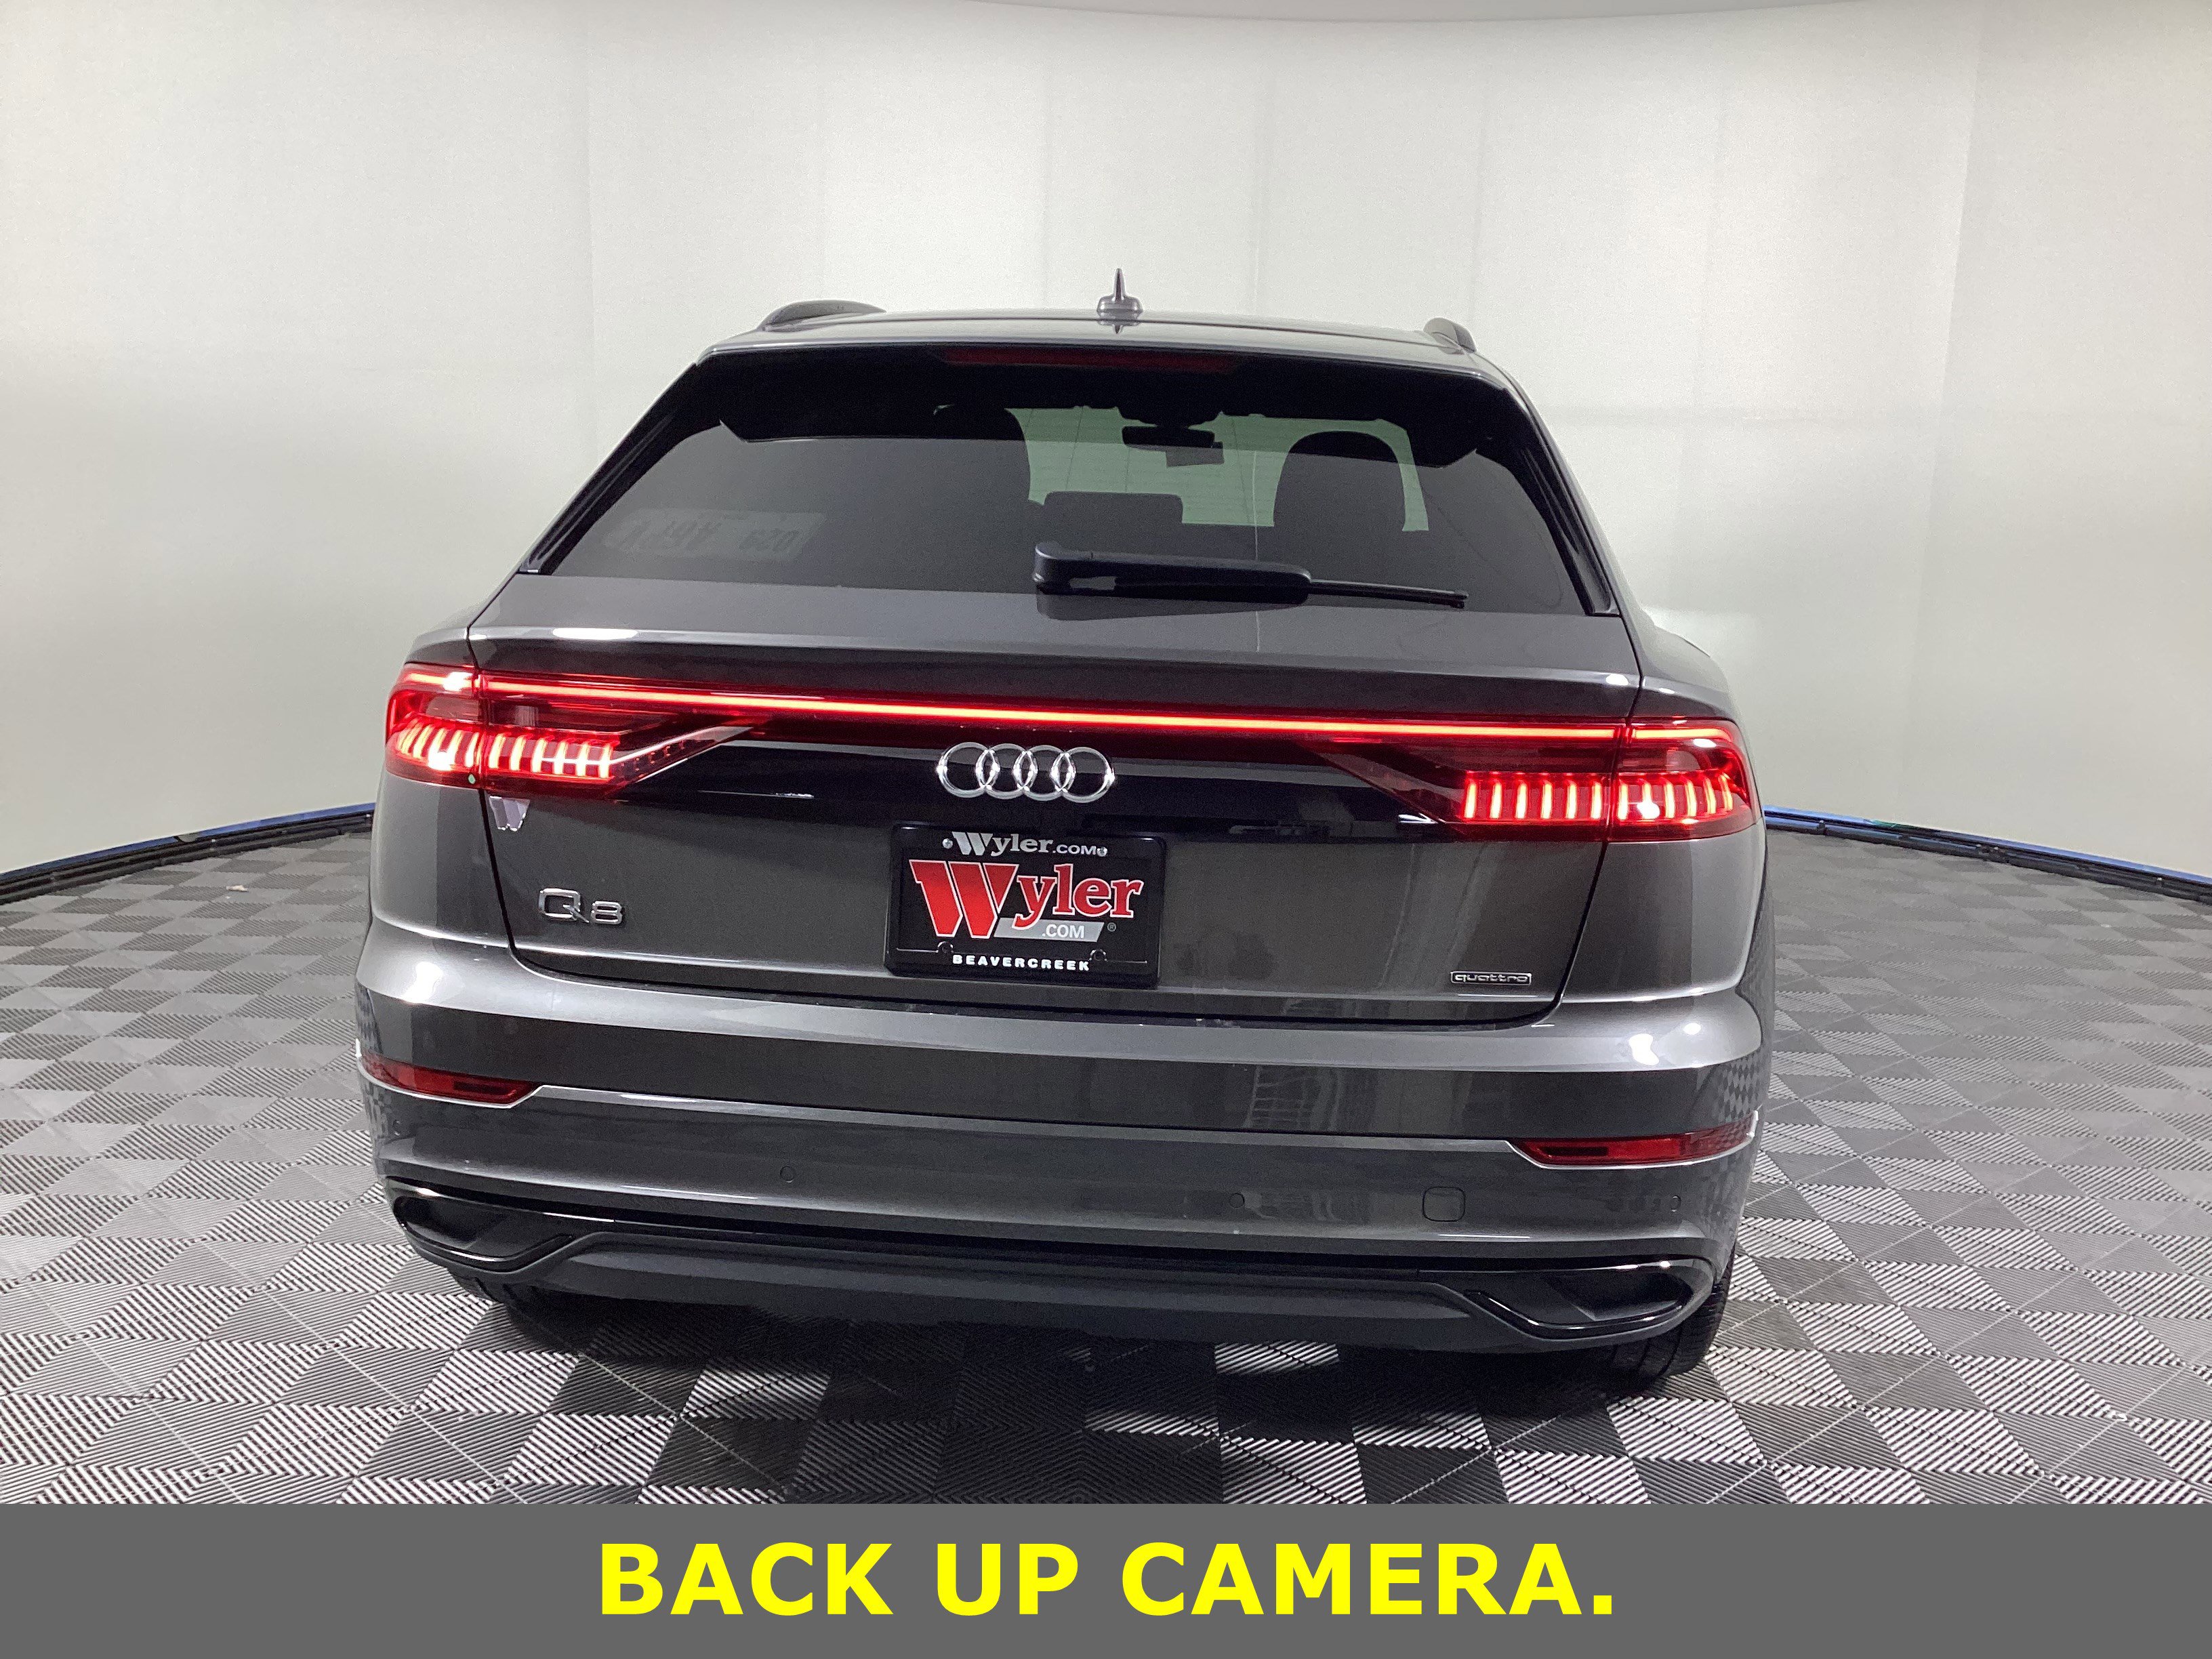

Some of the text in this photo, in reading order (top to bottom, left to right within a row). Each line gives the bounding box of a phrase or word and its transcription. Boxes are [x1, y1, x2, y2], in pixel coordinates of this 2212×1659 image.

[538, 888, 623, 924] Q8
[909, 859, 1144, 939] Wyler
[952, 954, 1090, 971] BEAVERCREEK
[1454, 973, 1528, 983] quattro
